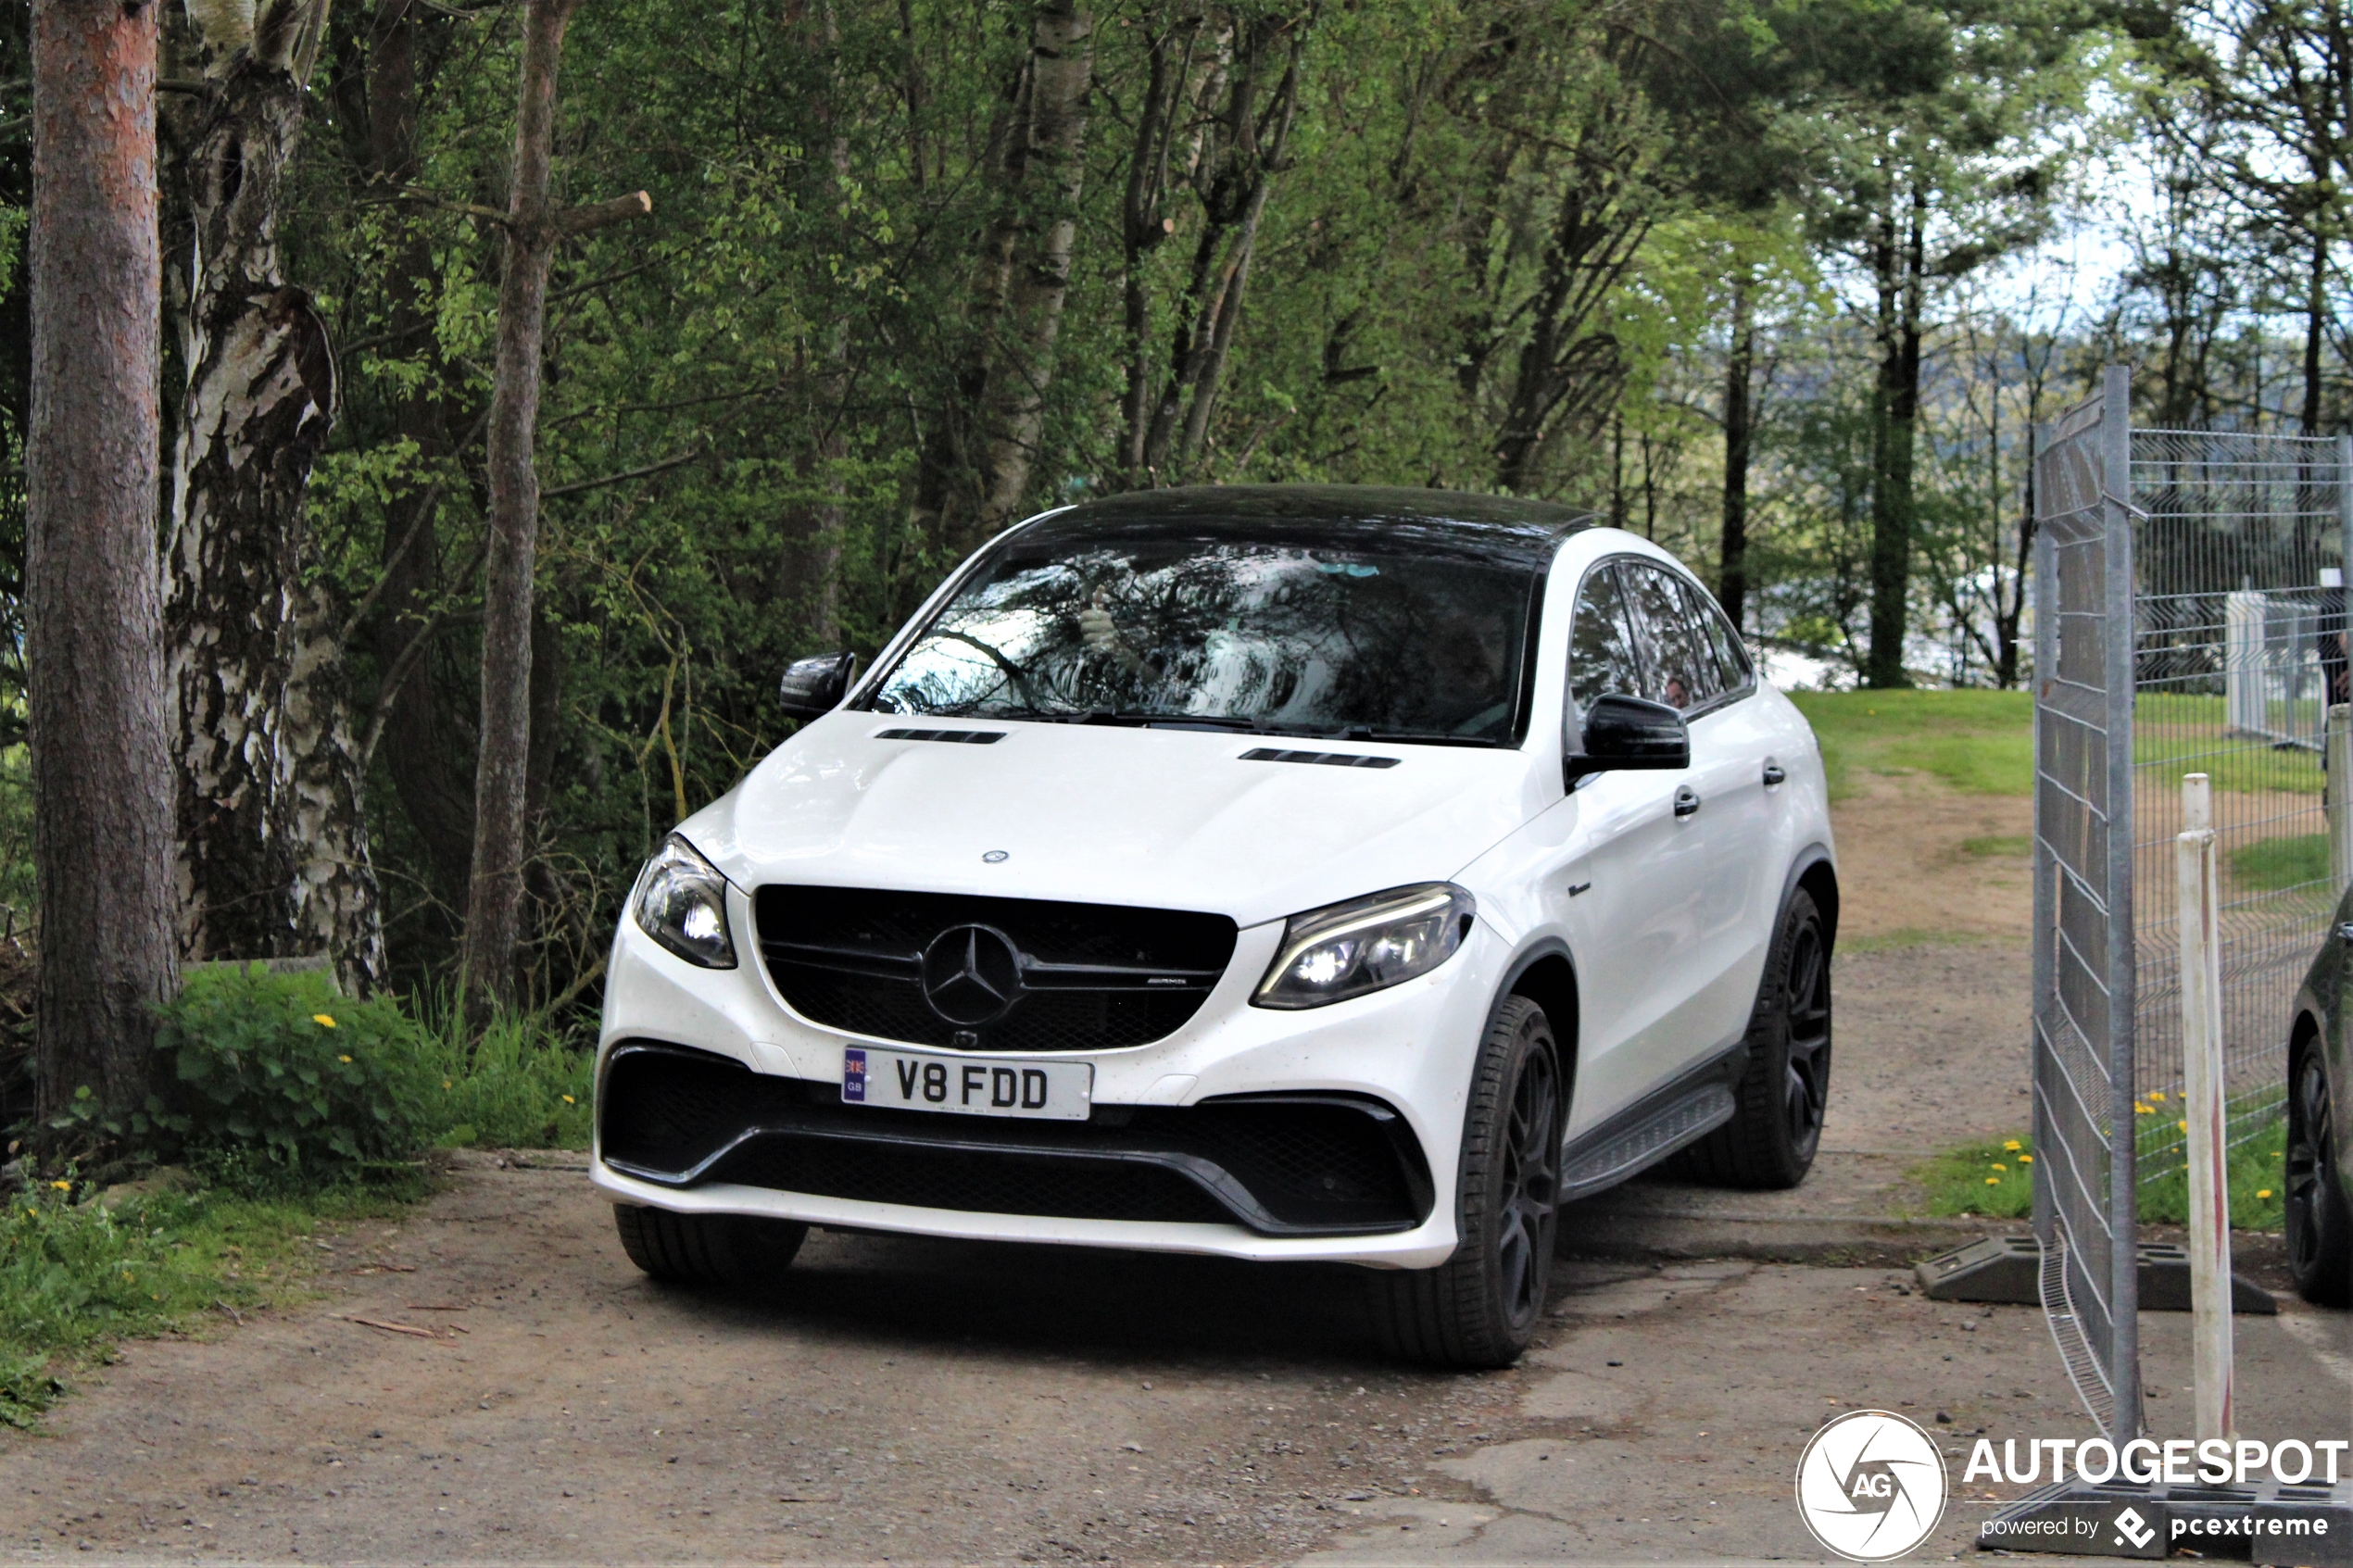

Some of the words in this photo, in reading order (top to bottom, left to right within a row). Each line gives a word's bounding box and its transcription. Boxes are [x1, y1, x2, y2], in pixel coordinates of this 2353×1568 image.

[848, 1082, 862, 1092] GB
[896, 1059, 948, 1103] V8
[962, 1065, 1048, 1110] FDD
